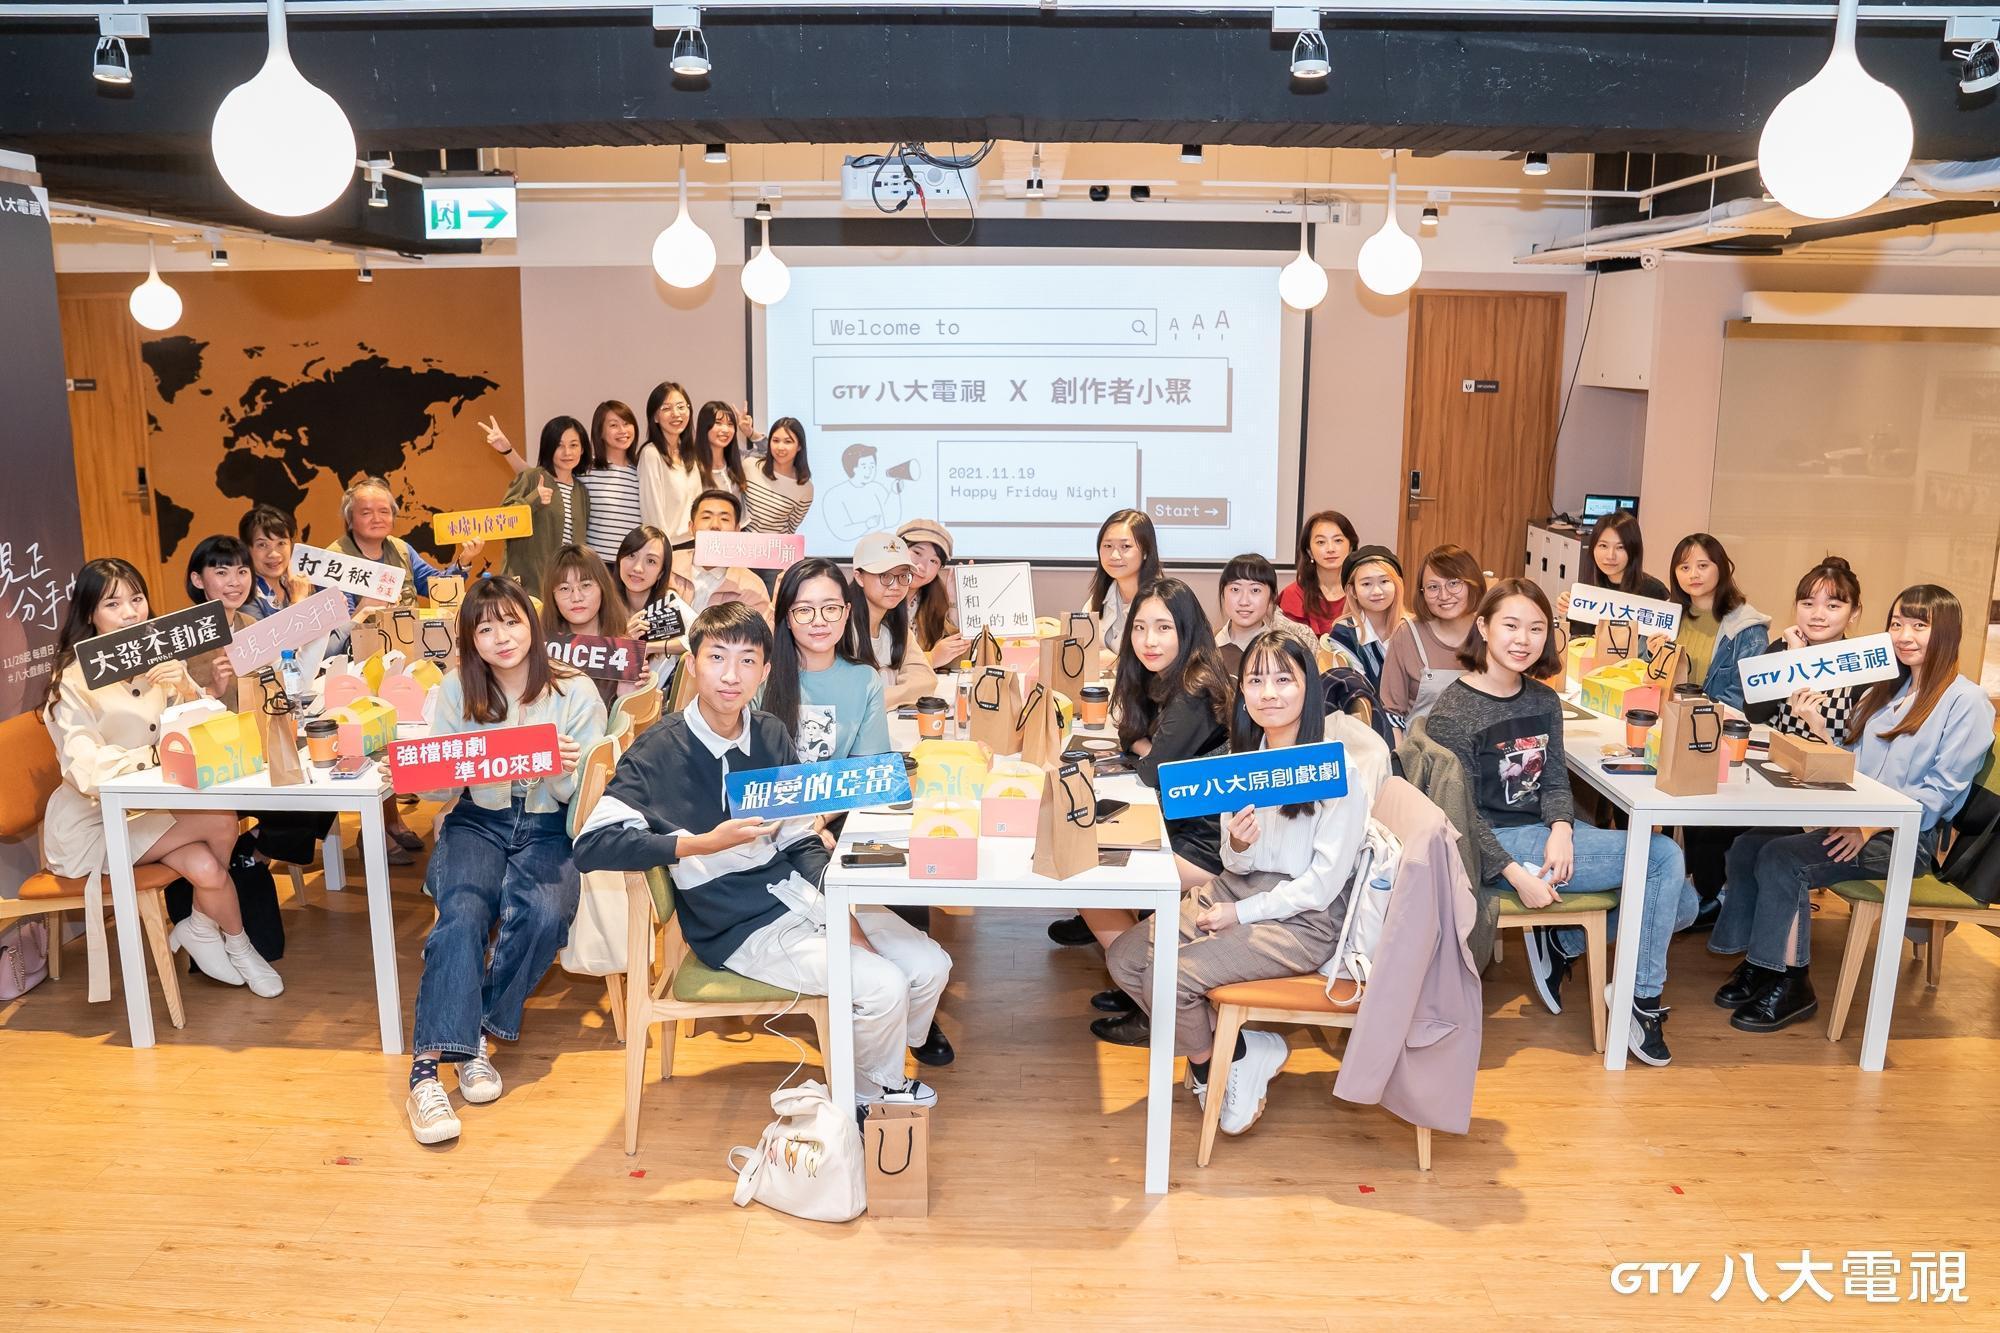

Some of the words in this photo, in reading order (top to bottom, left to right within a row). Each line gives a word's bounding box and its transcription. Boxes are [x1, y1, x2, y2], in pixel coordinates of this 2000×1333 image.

[830, 318, 921, 336] Welcome
[936, 318, 960, 336] to
[1215, 310, 1230, 329] A
[832, 384, 870, 400] GTV
[875, 379, 987, 403] 八大電視
[1010, 379, 1028, 402] X
[1051, 376, 1192, 405] 創作者小聚
[948, 466, 1035, 480] 2021.11.19
[951, 485, 997, 501] Happy
[1006, 485, 1058, 501] Friday
[1067, 485, 1117, 500] Night!
[1154, 503, 1200, 518] Start
[1573, 598, 1597, 610] GTV
[1600, 602, 1674, 630] 八大電視
[90, 614, 220, 681] 大發不動產
[544, 641, 607, 669] OICE
[609, 648, 629, 671] 4
[1747, 669, 1781, 687] GTV
[1787, 647, 1890, 683] 八大電視
[396, 736, 487, 767] 強檔韓劇
[454, 751, 553, 782] 準10來襲
[1168, 784, 1200, 799] GTV
[1203, 760, 1340, 797] 八大原創戲劇
